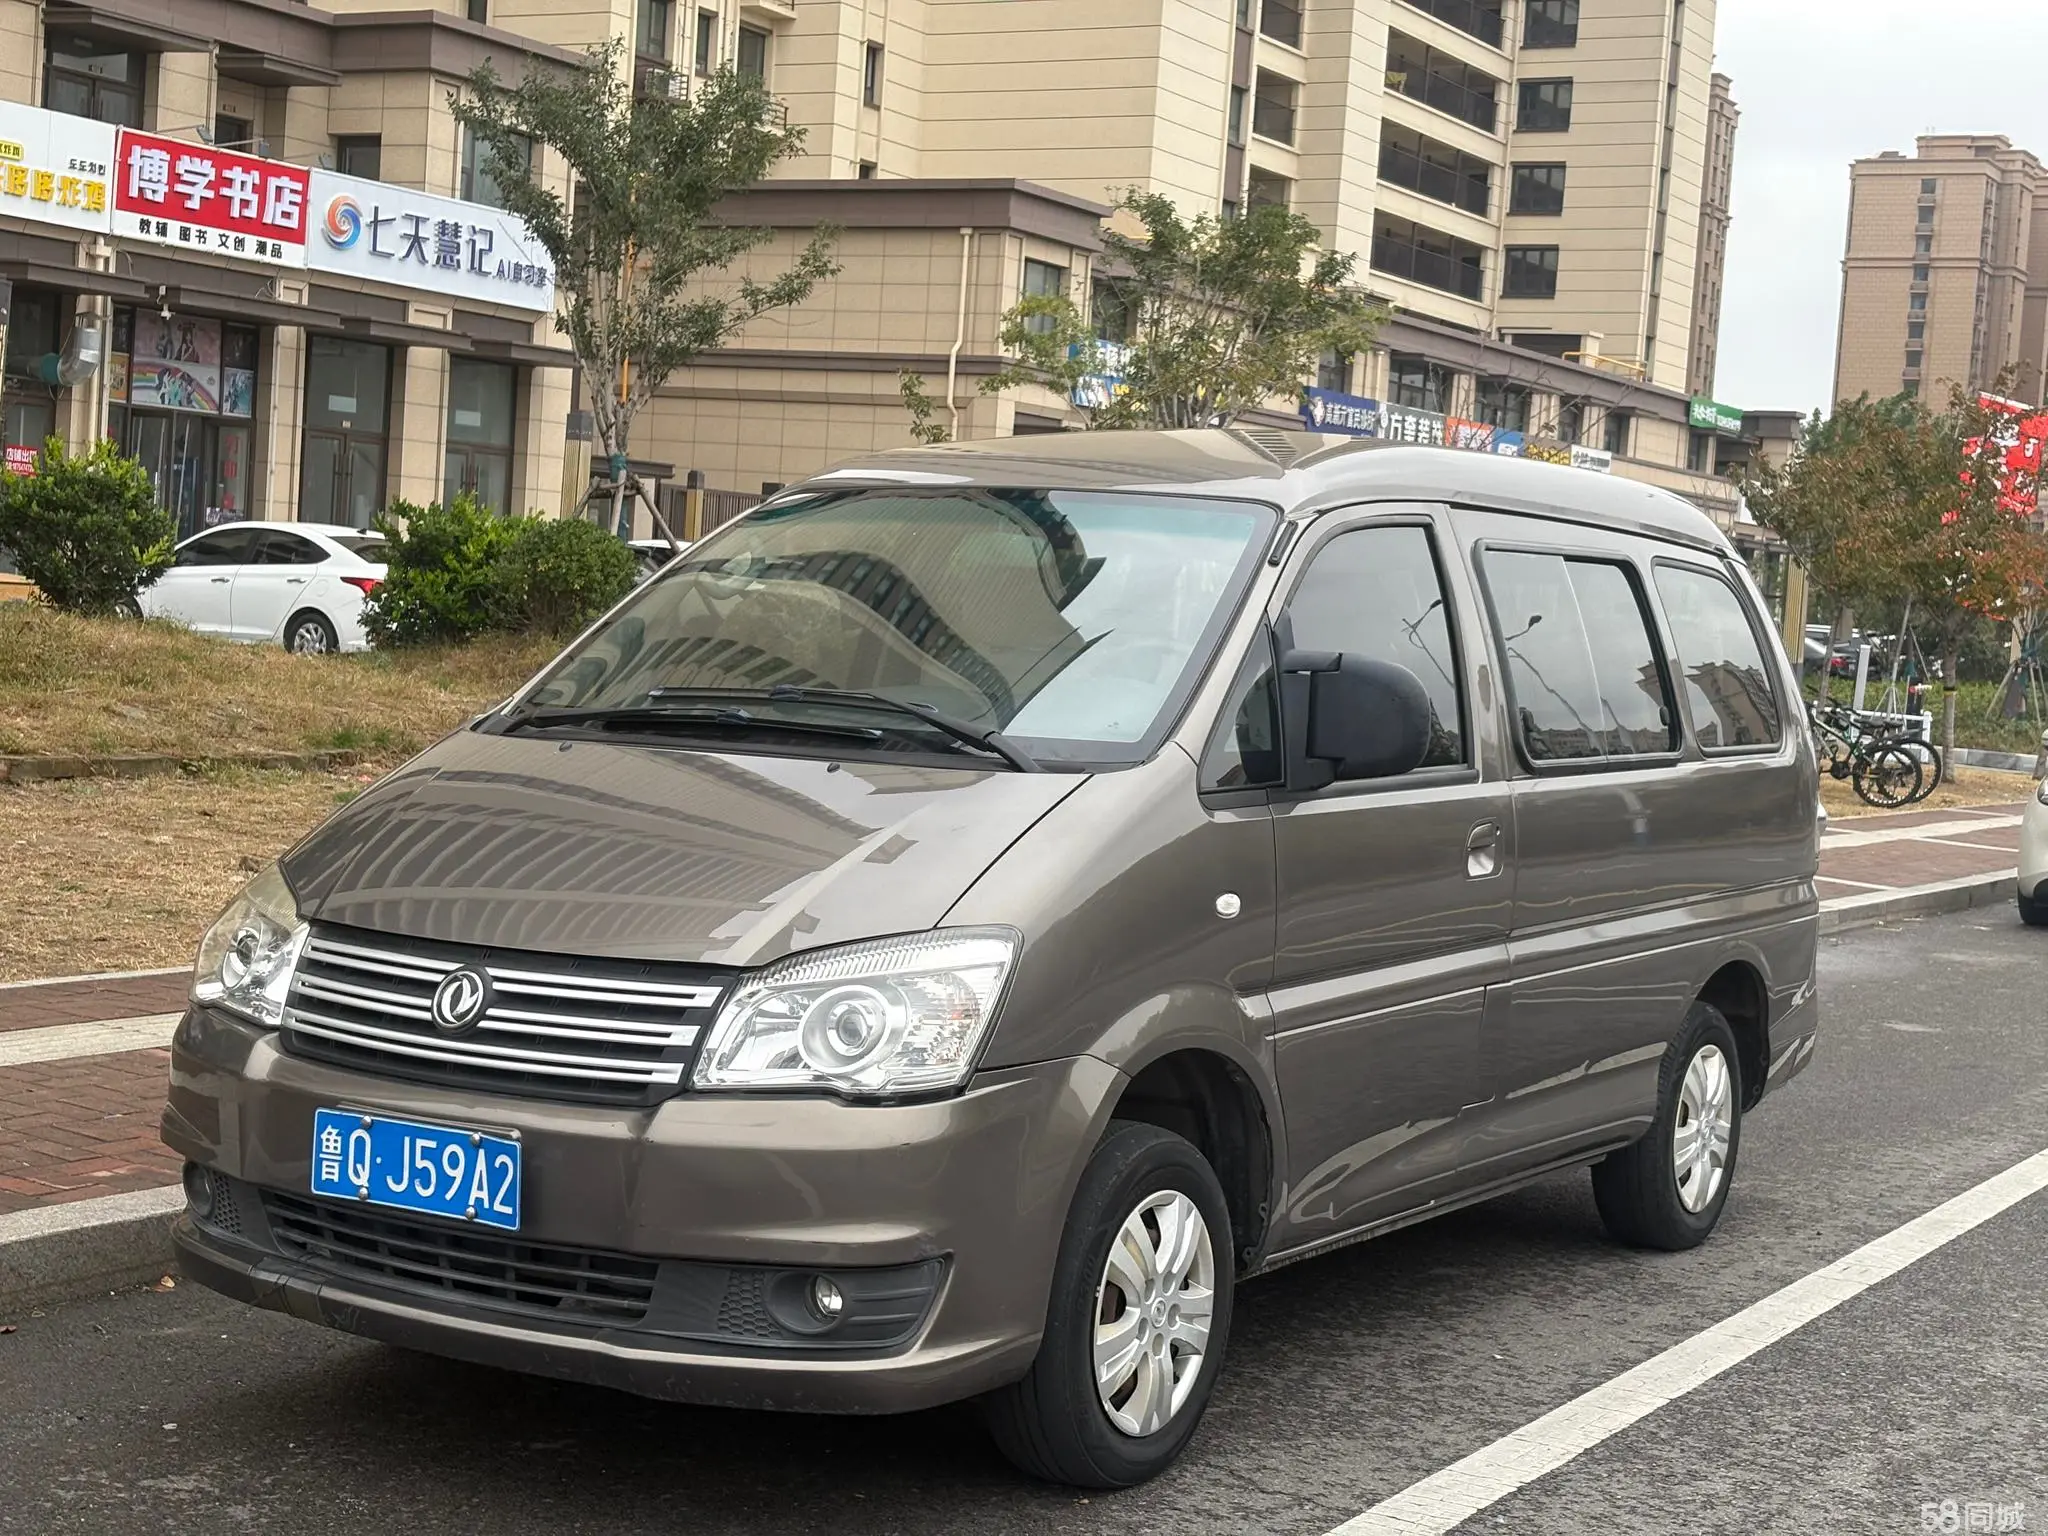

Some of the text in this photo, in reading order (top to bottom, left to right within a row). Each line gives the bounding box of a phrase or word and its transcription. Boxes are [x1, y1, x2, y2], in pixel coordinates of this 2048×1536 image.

[0, 162, 106, 213] 哆哆炸鸡
[128, 145, 303, 229] 博学书店
[138, 218, 283, 258] 教辅 图书 文创 潮品
[367, 205, 494, 276] 七天慧记
[319, 1124, 515, 1215] 鲁Q·J59A2
